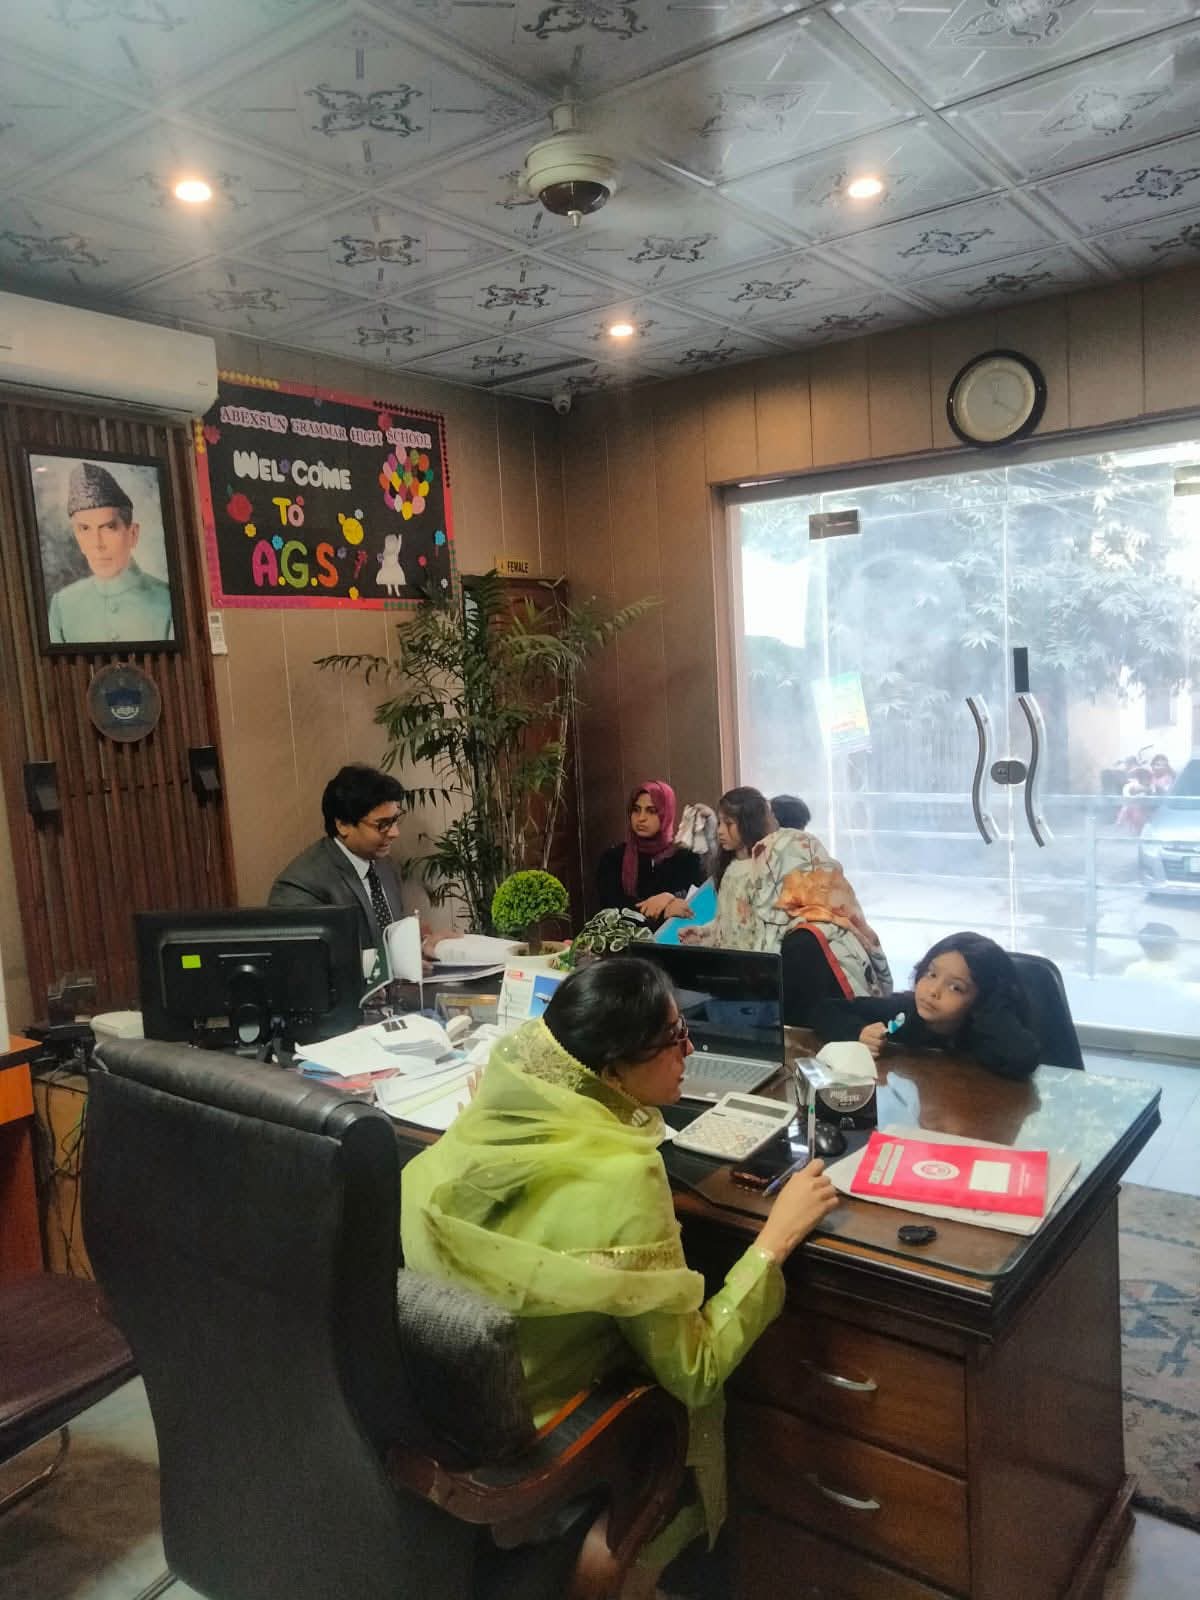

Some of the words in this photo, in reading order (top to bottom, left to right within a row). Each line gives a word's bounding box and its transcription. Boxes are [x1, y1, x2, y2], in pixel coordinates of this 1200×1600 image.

[221, 407, 287, 432] ABEXSUN
[292, 420, 347, 440] GRAMMAR
[351, 428, 382, 445] HIGH
[386, 428, 431, 447] SCHOOL
[272, 497, 305, 527] TO
[507, 560, 529, 574] FEMALE
